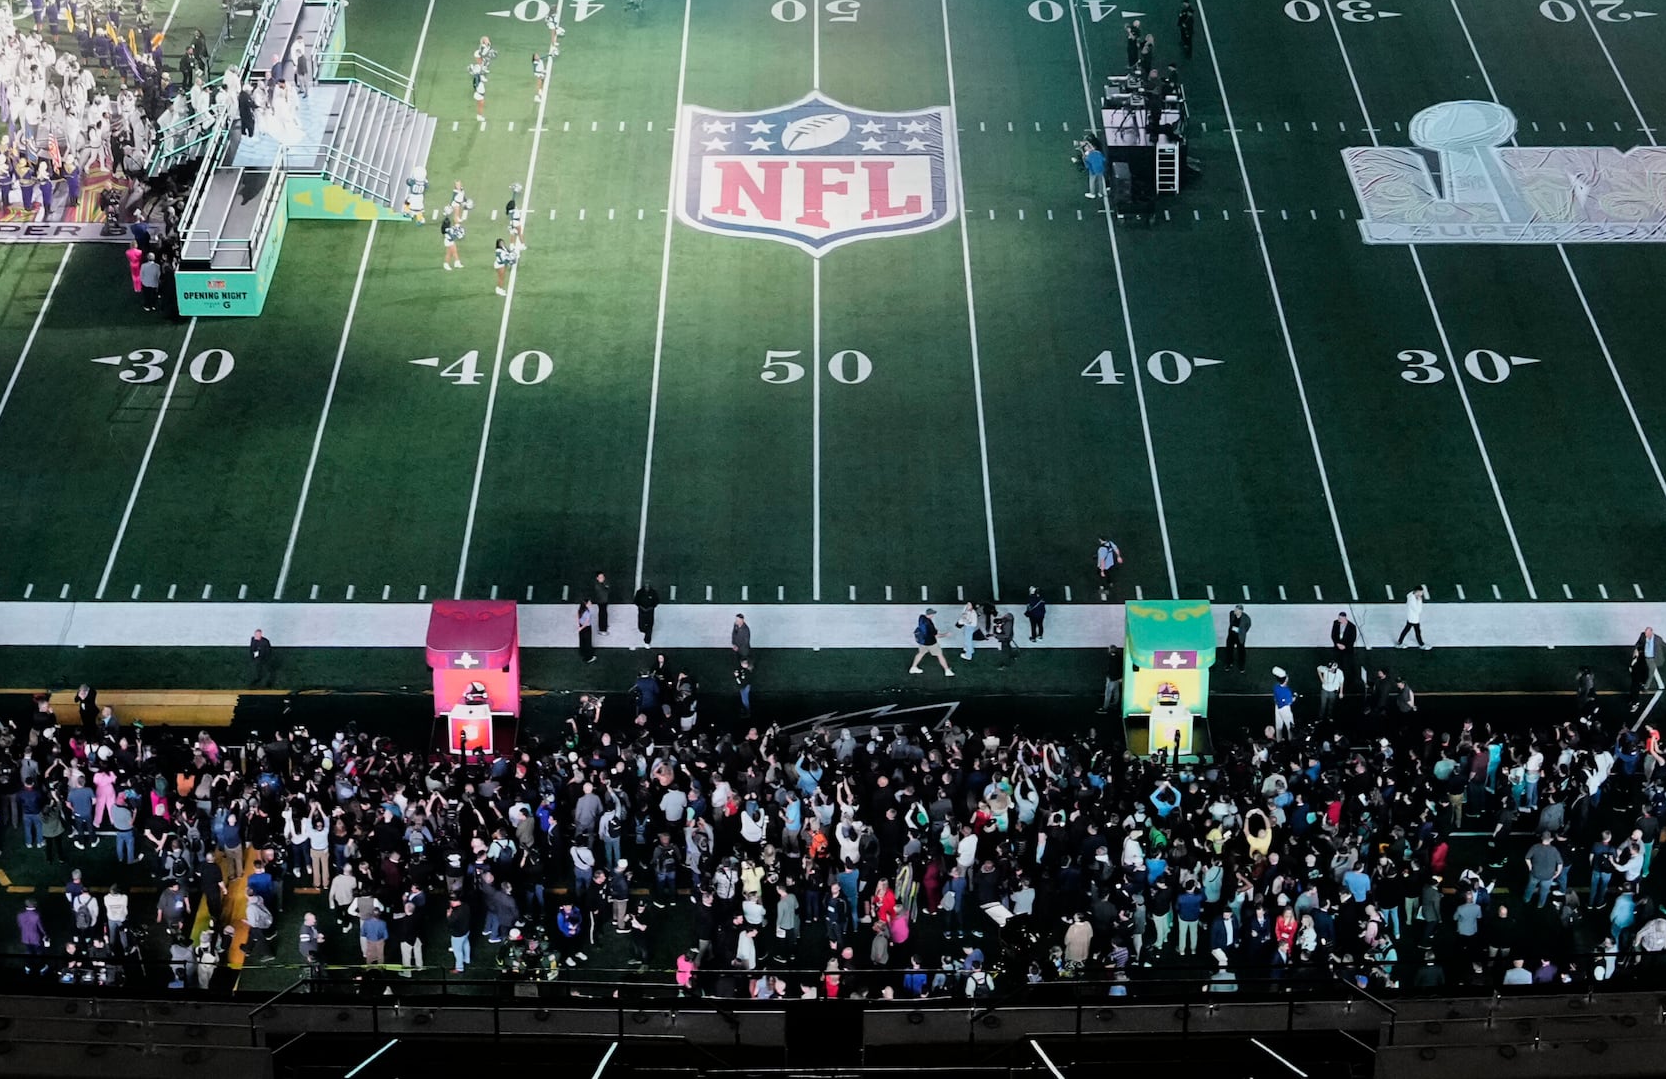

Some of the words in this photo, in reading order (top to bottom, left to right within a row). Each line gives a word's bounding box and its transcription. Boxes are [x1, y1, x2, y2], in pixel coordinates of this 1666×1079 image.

[771, 0, 861, 22] 50
[1028, 0, 1117, 22] 40
[1285, 0, 1374, 22] 30
[1540, 0, 1632, 22] 20
[712, 161, 922, 229] NFL
[1409, 225, 1562, 238] SUPER
[184, 292, 219, 300] OPENING
[222, 292, 247, 300] NIGHT
[119, 349, 234, 383] 30
[440, 350, 553, 384] 40
[761, 350, 872, 384] 50
[1081, 350, 1192, 384] 40
[1397, 349, 1510, 383] 30
